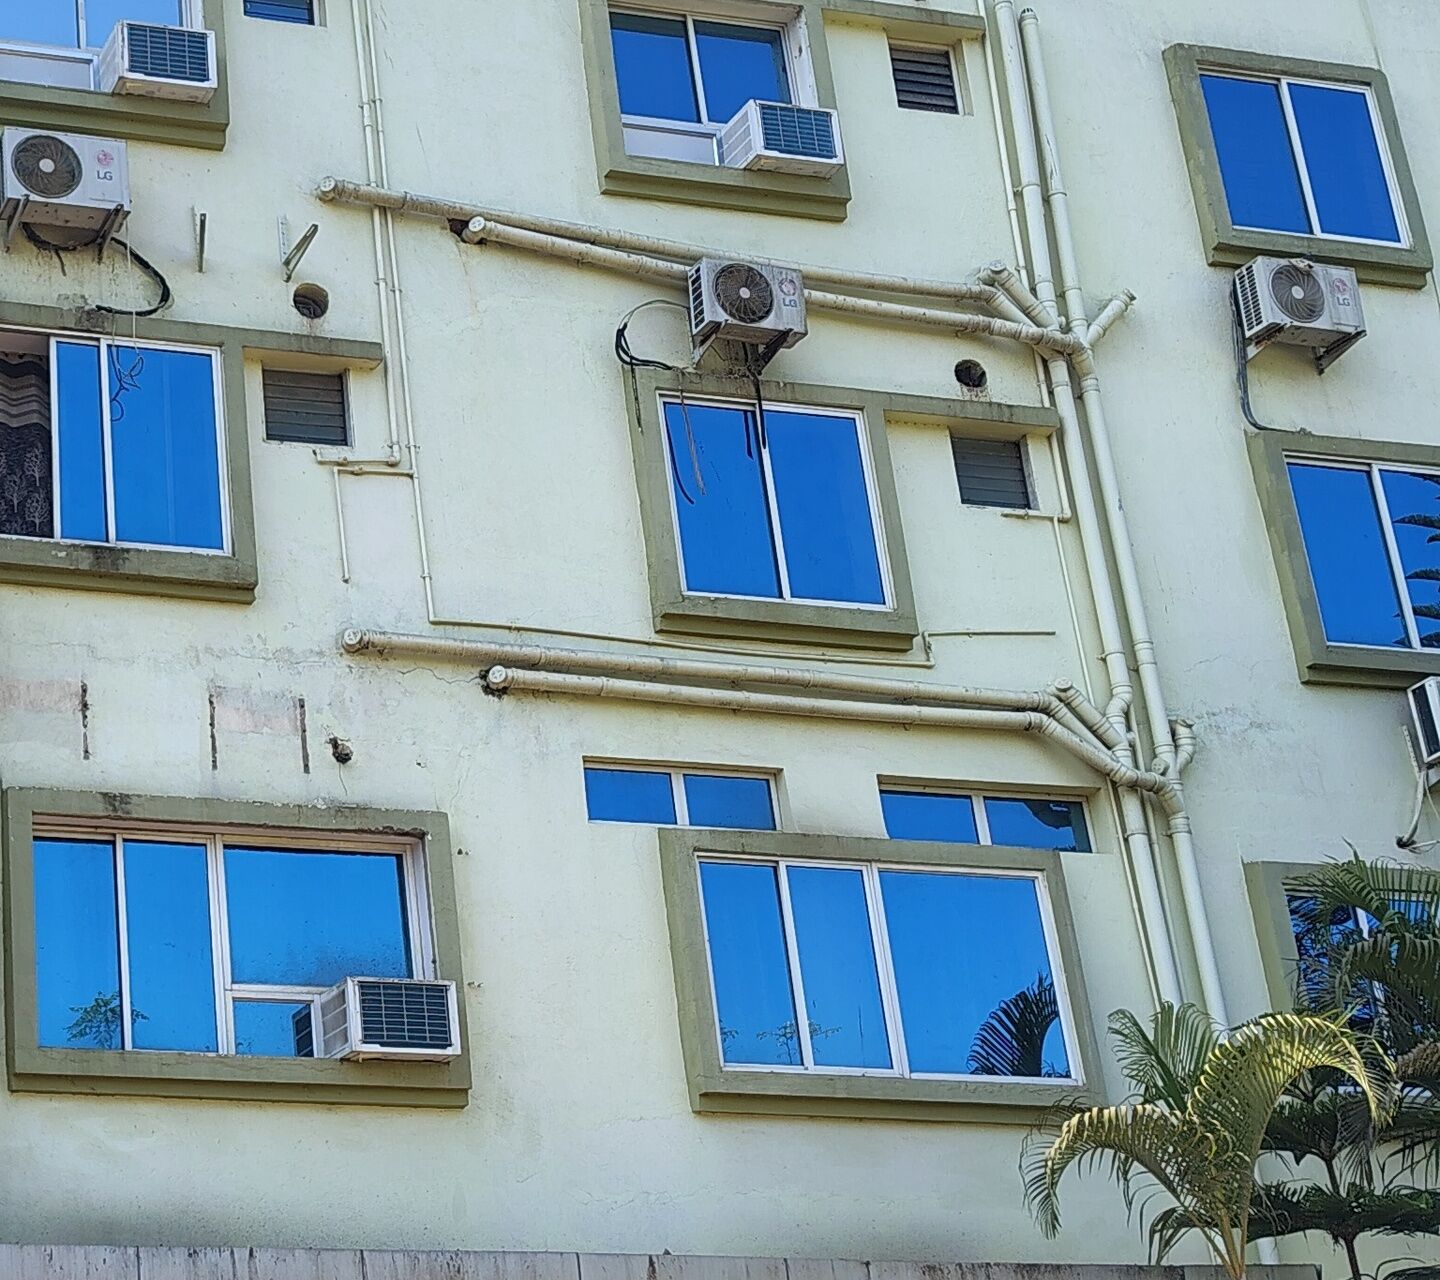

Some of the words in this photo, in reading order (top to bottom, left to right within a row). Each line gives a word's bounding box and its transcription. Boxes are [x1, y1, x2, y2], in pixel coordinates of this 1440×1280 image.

[96, 169, 113, 182] LG
[782, 297, 799, 309] LG
[1336, 295, 1351, 307] LG
